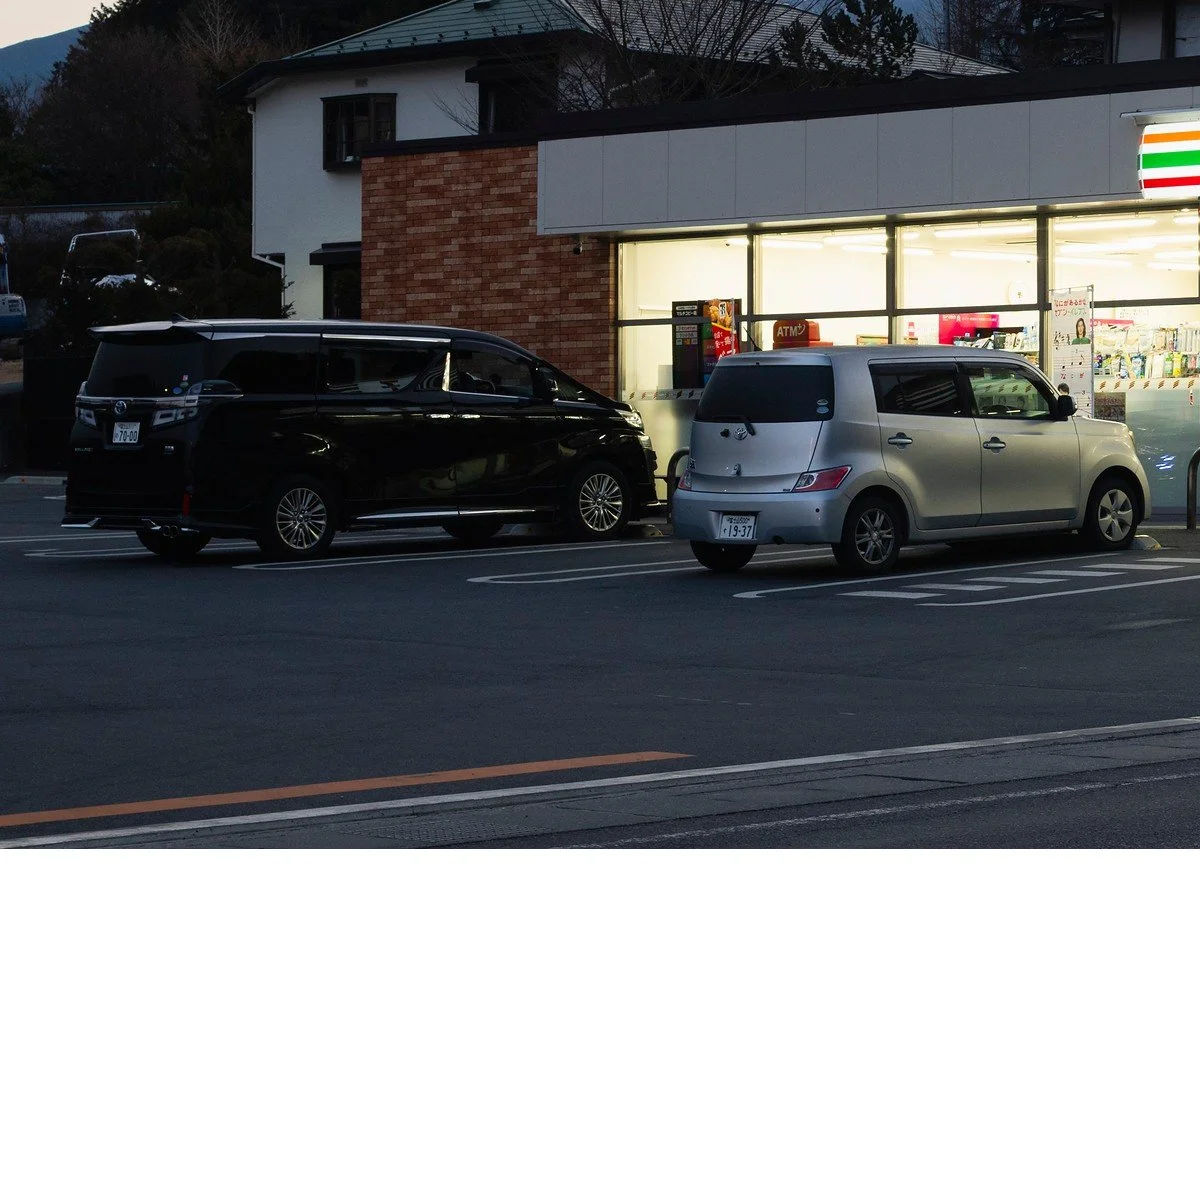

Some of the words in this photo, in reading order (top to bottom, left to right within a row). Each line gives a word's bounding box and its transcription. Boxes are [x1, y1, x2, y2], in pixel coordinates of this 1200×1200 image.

[776, 325, 798, 337] ATM
[118, 430, 138, 441] 70-00
[728, 525, 752, 537] 19-37
